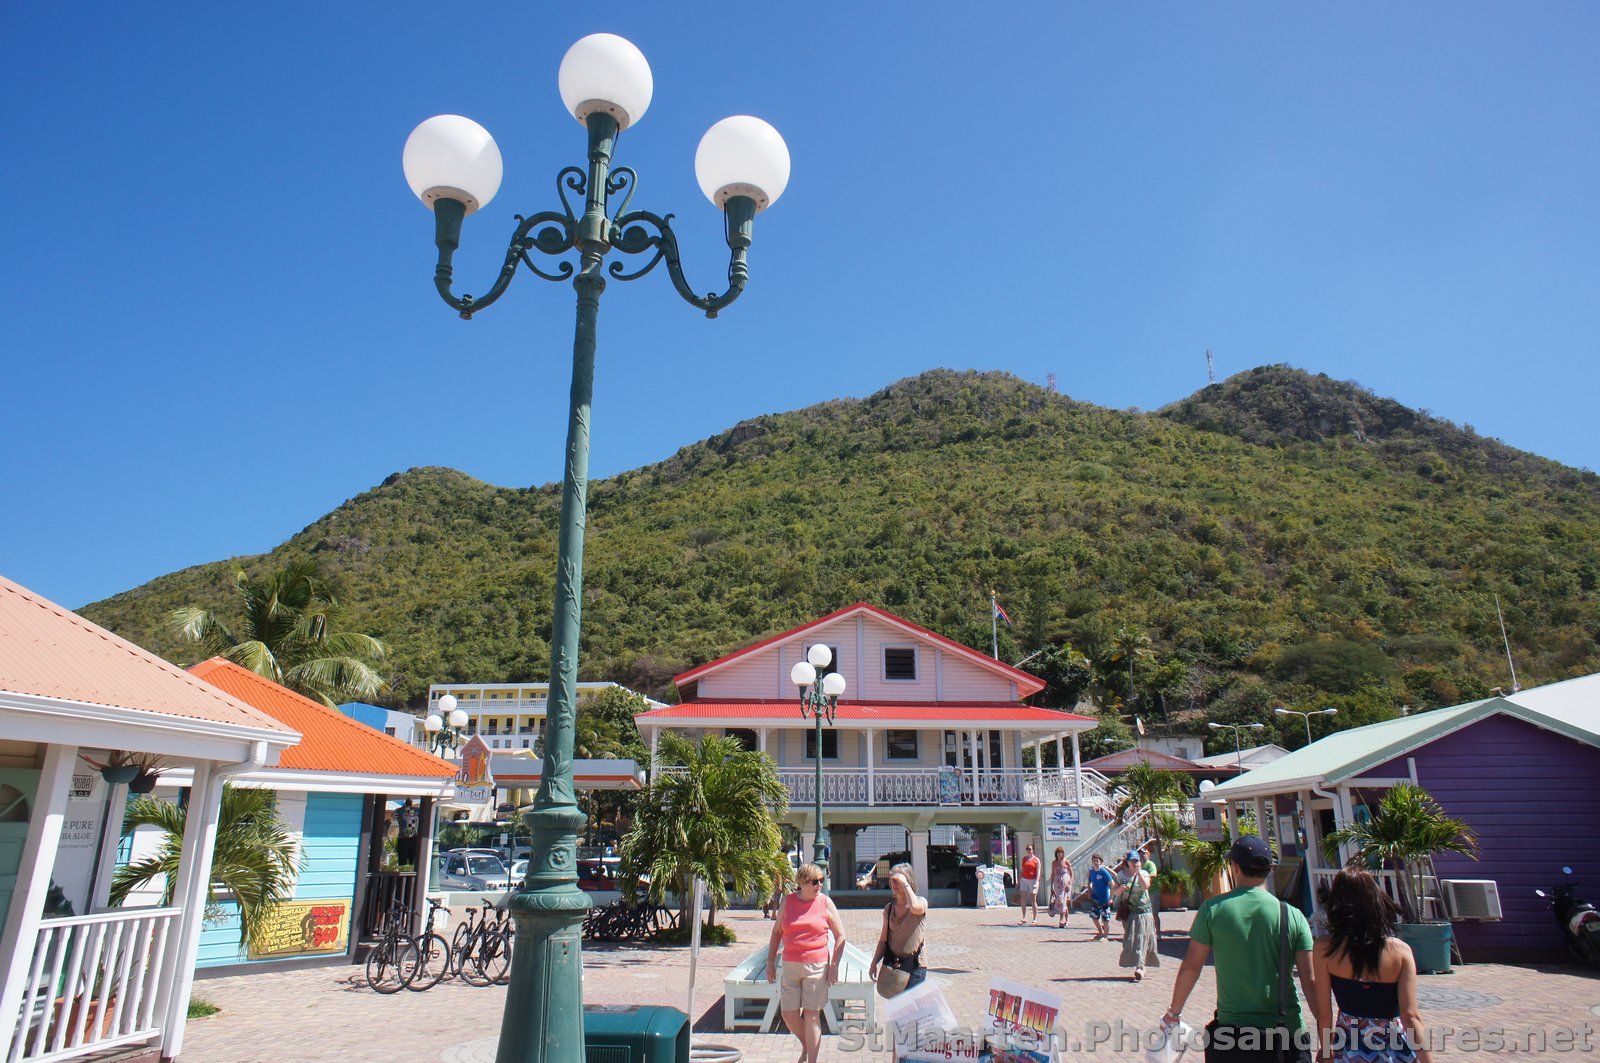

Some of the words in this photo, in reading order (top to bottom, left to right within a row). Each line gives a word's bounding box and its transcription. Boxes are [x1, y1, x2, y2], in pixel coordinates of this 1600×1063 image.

[70, 821, 93, 829] PURE
[311, 905, 345, 917] BICYCLE
[314, 915, 340, 926] TOURS
[313, 926, 339, 947] $49
[988, 988, 1023, 1024] TIKI
[1021, 999, 1059, 1035] HUT
